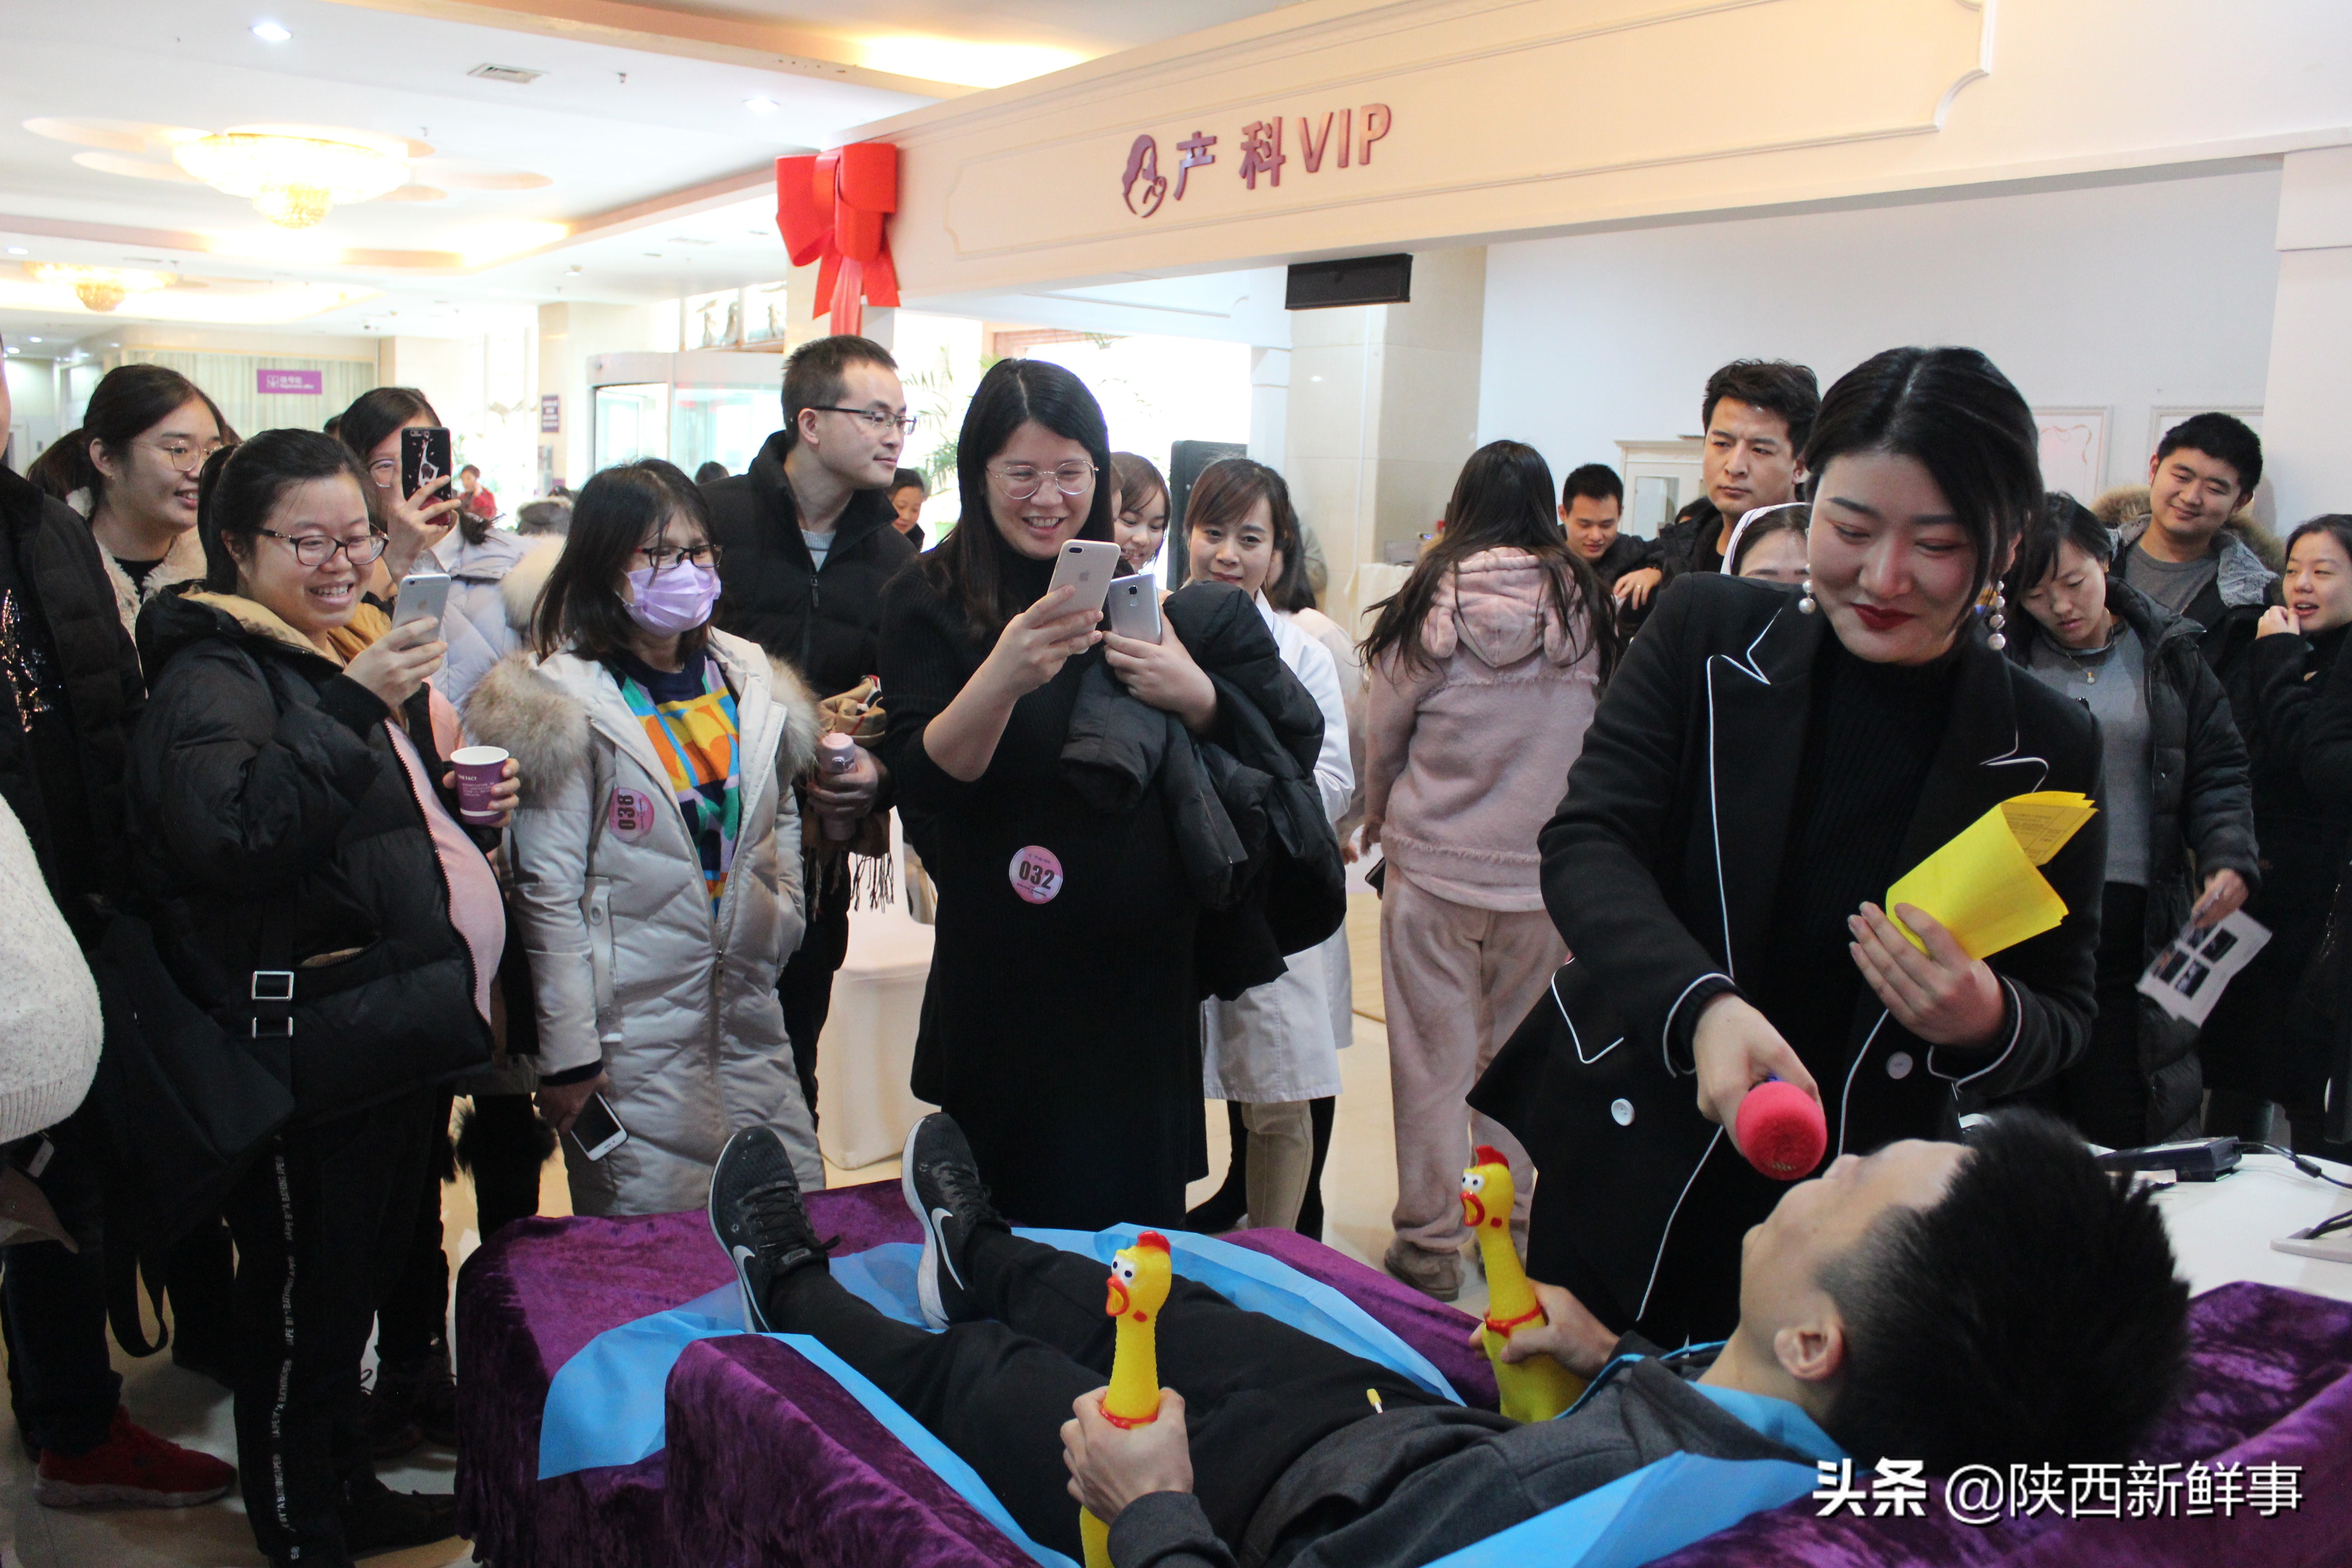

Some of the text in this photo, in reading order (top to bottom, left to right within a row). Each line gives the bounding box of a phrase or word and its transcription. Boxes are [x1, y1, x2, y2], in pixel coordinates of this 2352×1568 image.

[1173, 103, 1392, 201] 产科VIP
[617, 795, 636, 830] 038
[1019, 861, 1054, 890] 032
